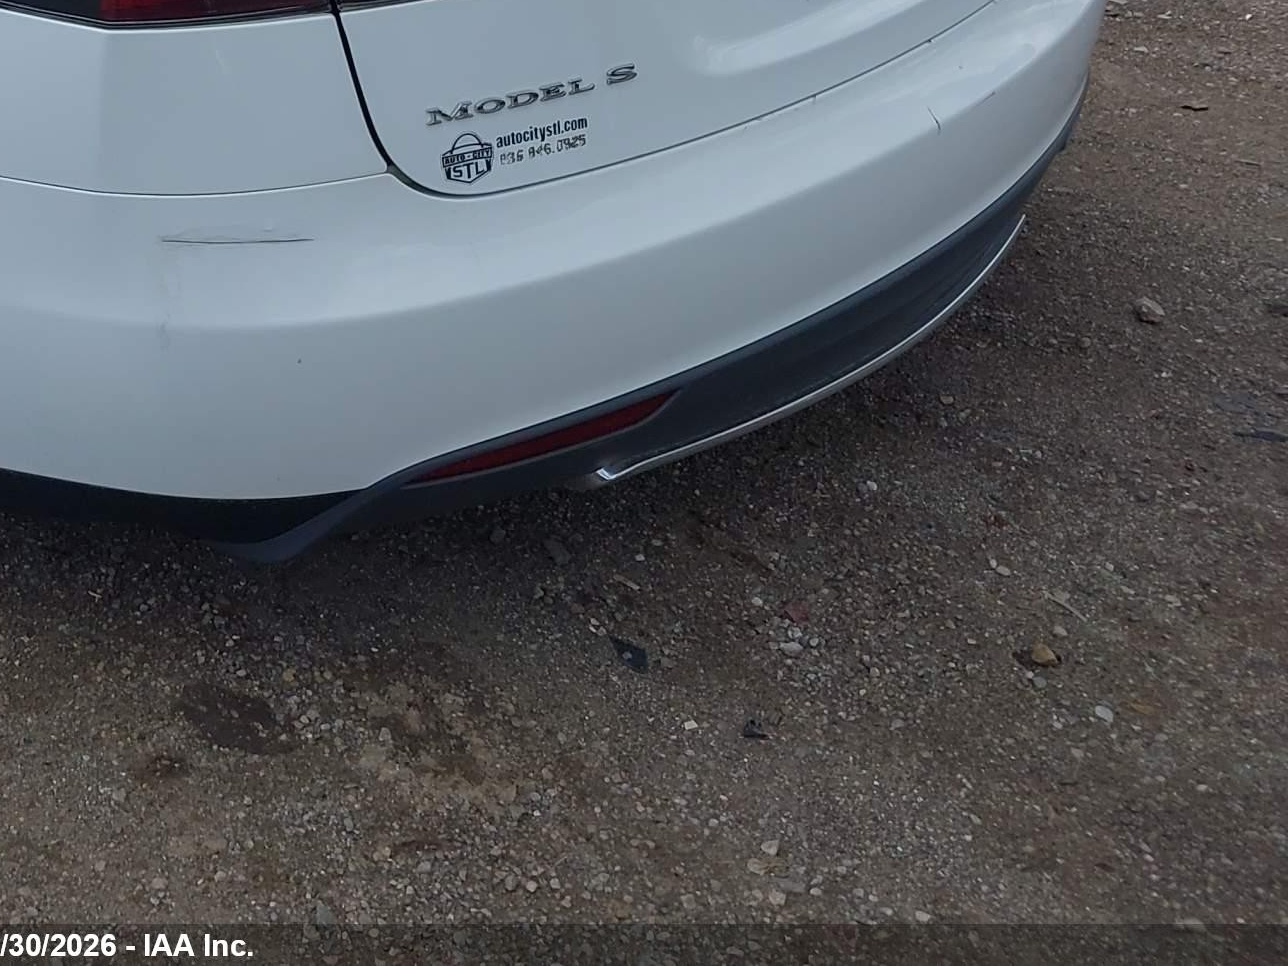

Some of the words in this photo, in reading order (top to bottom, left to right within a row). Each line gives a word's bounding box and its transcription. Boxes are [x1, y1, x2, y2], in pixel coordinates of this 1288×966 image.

[425, 78, 596, 126] MODEL
[606, 62, 638, 85] S
[496, 116, 589, 147] autocitystl.com
[452, 161, 486, 179] STL
